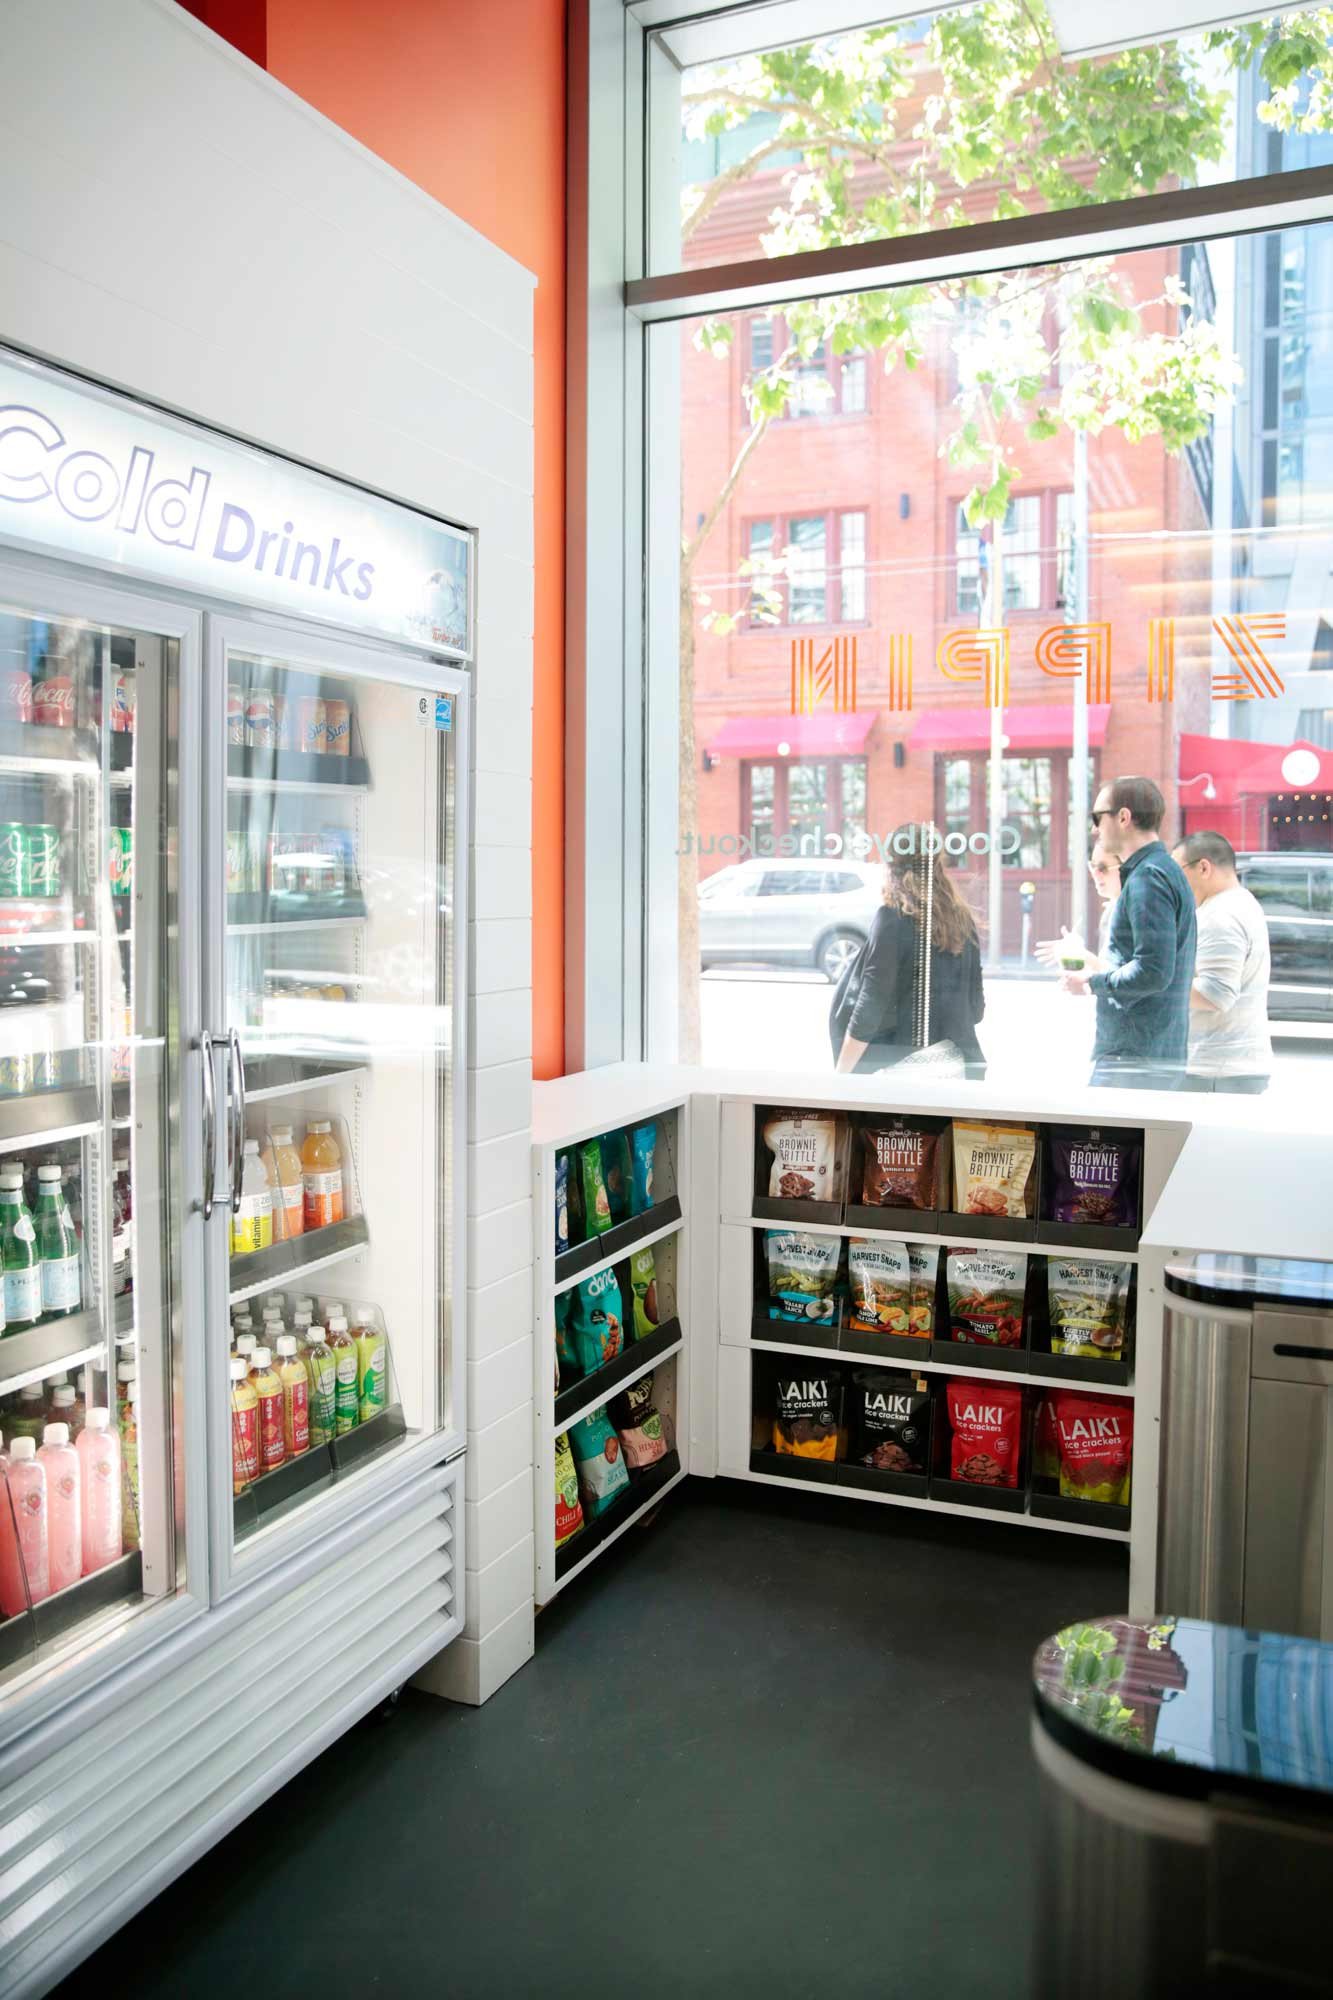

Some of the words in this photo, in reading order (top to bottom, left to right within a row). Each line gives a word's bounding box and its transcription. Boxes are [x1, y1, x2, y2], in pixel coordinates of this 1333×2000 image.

[0, 405, 212, 550] Cold
[213, 502, 376, 601] Drinks
[779, 1137, 817, 1151] BROWNIE
[877, 1136, 923, 1151] BROWNIE
[877, 1150, 923, 1166] BRITTLE
[971, 1150, 1015, 1166] BROWNIE
[1070, 1151, 1119, 1167] BROWNIE
[969, 1163, 1013, 1179] BRITTLE
[1069, 1165, 1119, 1182] BRITTLE
[852, 1250, 880, 1262] HARVEST
[880, 1252, 902, 1269] SNAPS
[909, 1255, 928, 1269] NAPS
[778, 1380, 828, 1401] LAIKI
[793, 1399, 828, 1409] crackers
[864, 1391, 912, 1414] LAIKI
[864, 1409, 877, 1417] rice
[878, 1412, 910, 1421] crackers
[955, 1403, 1003, 1424] LAIKI
[969, 1423, 1002, 1432] crackers
[1060, 1416, 1121, 1440] LAIKI
[1065, 1441, 1079, 1449] rice
[1081, 1437, 1122, 1448] crackers
